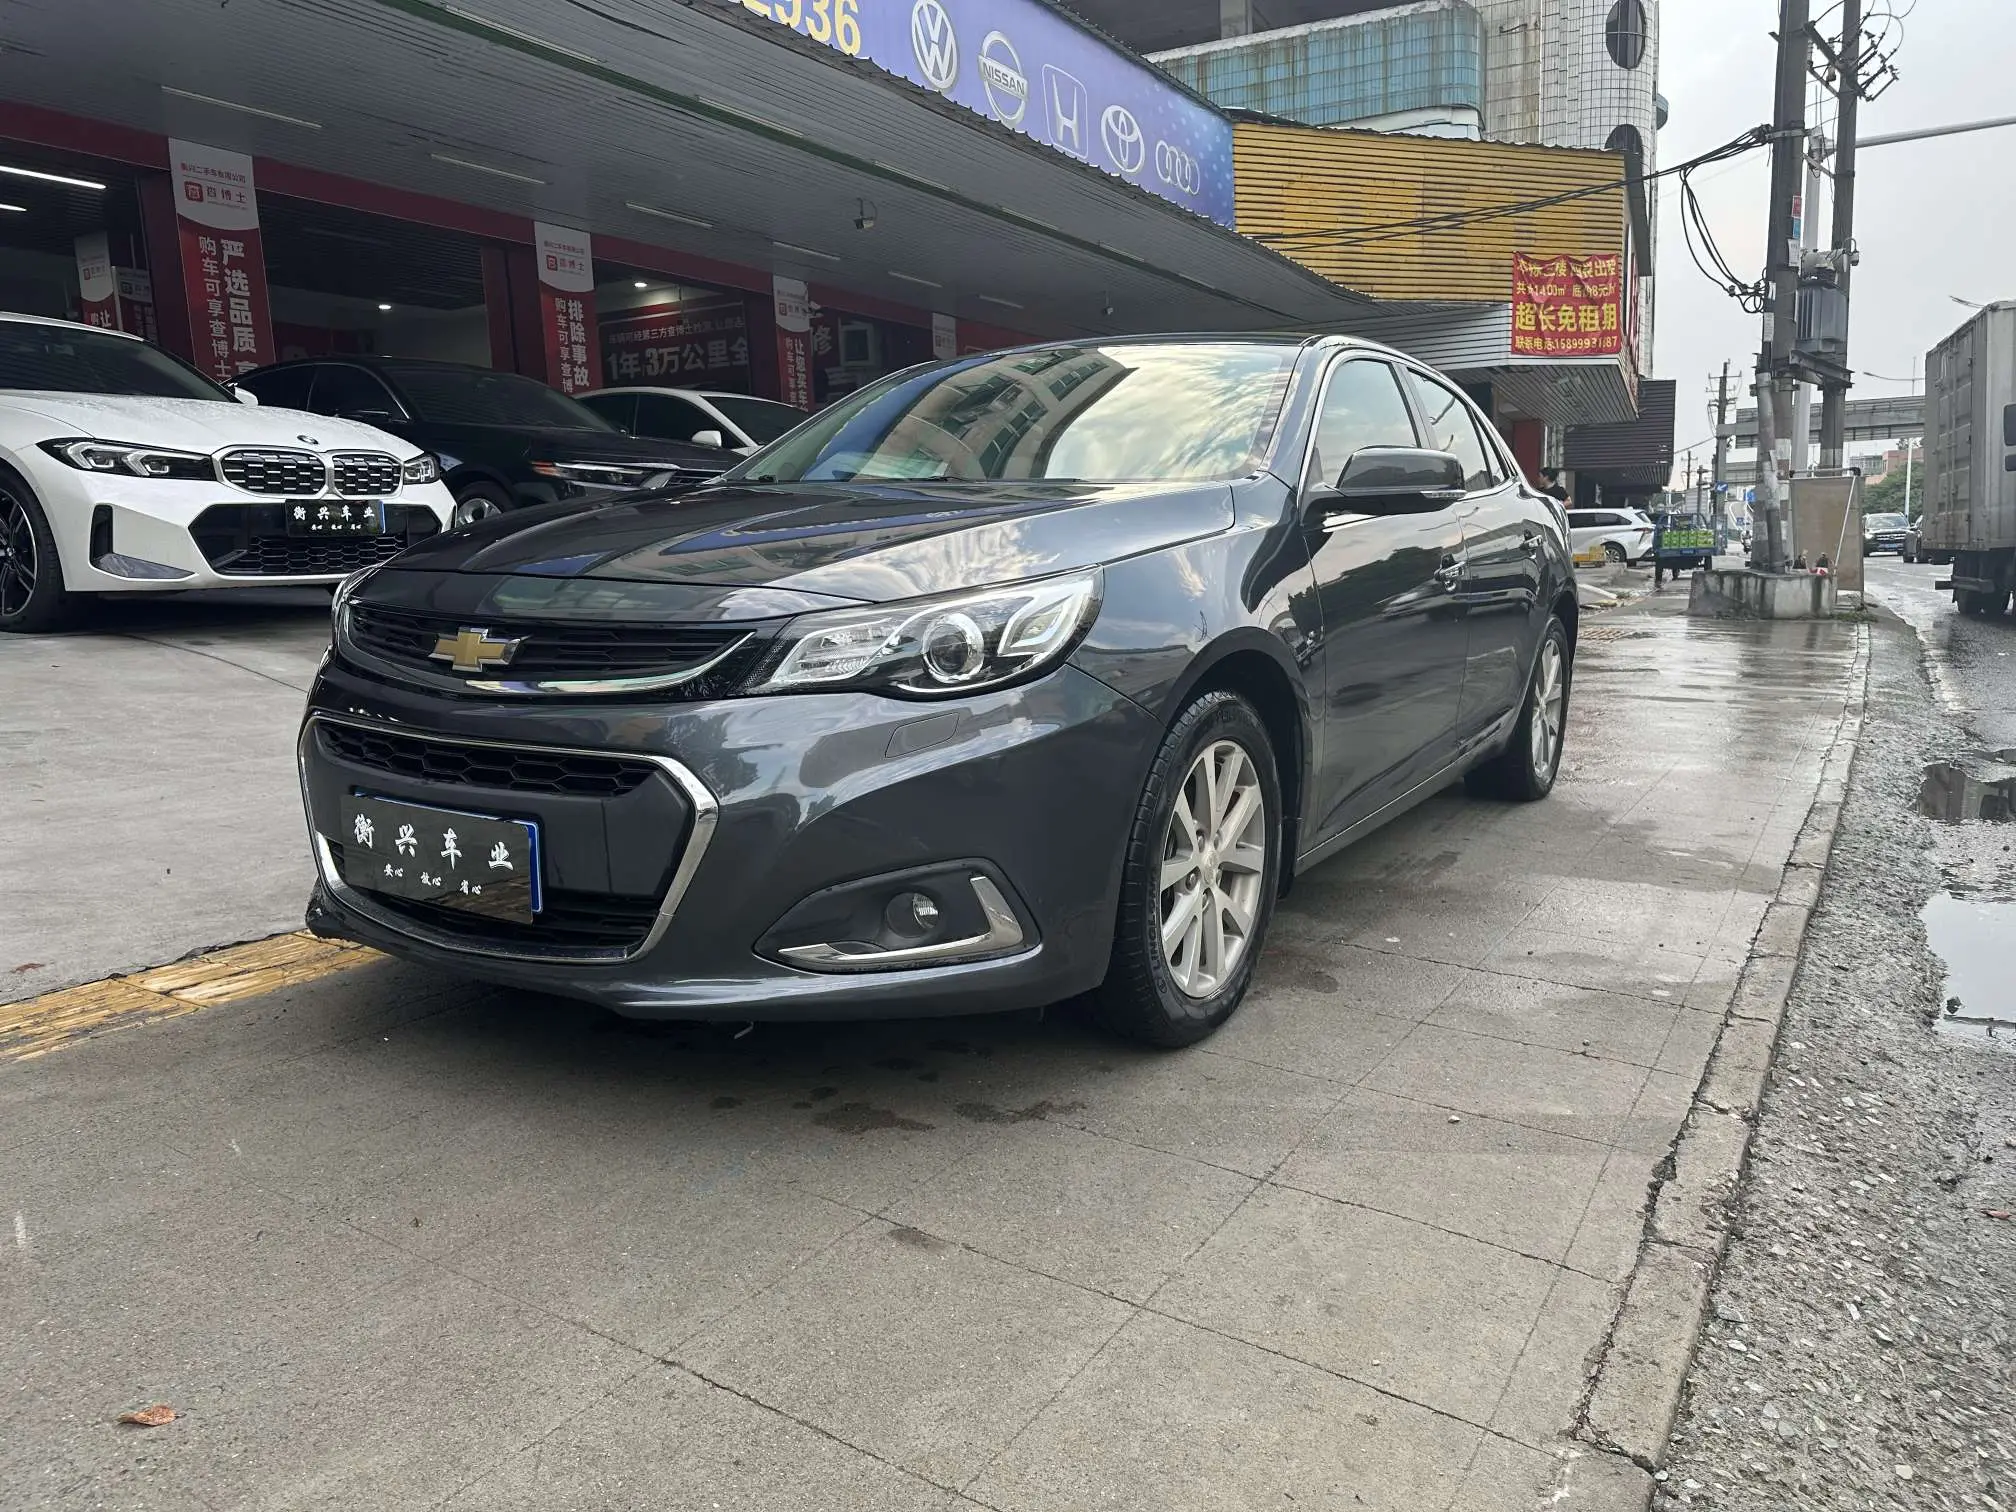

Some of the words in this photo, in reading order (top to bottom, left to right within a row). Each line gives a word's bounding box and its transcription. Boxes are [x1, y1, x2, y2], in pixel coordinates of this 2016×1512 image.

[744, 0, 861, 55] 36
[983, 63, 1025, 95] NISSAN
[199, 235, 233, 379] 购车可享查博士
[1515, 301, 1617, 332] 超长免租期
[568, 299, 590, 387] 排除事故
[293, 505, 375, 522] 衡兴车业
[353, 813, 514, 871] 衡兴车业
[383, 863, 403, 878] 安心
[420, 872, 442, 887] 放心
[459, 879, 482, 896] 省心
